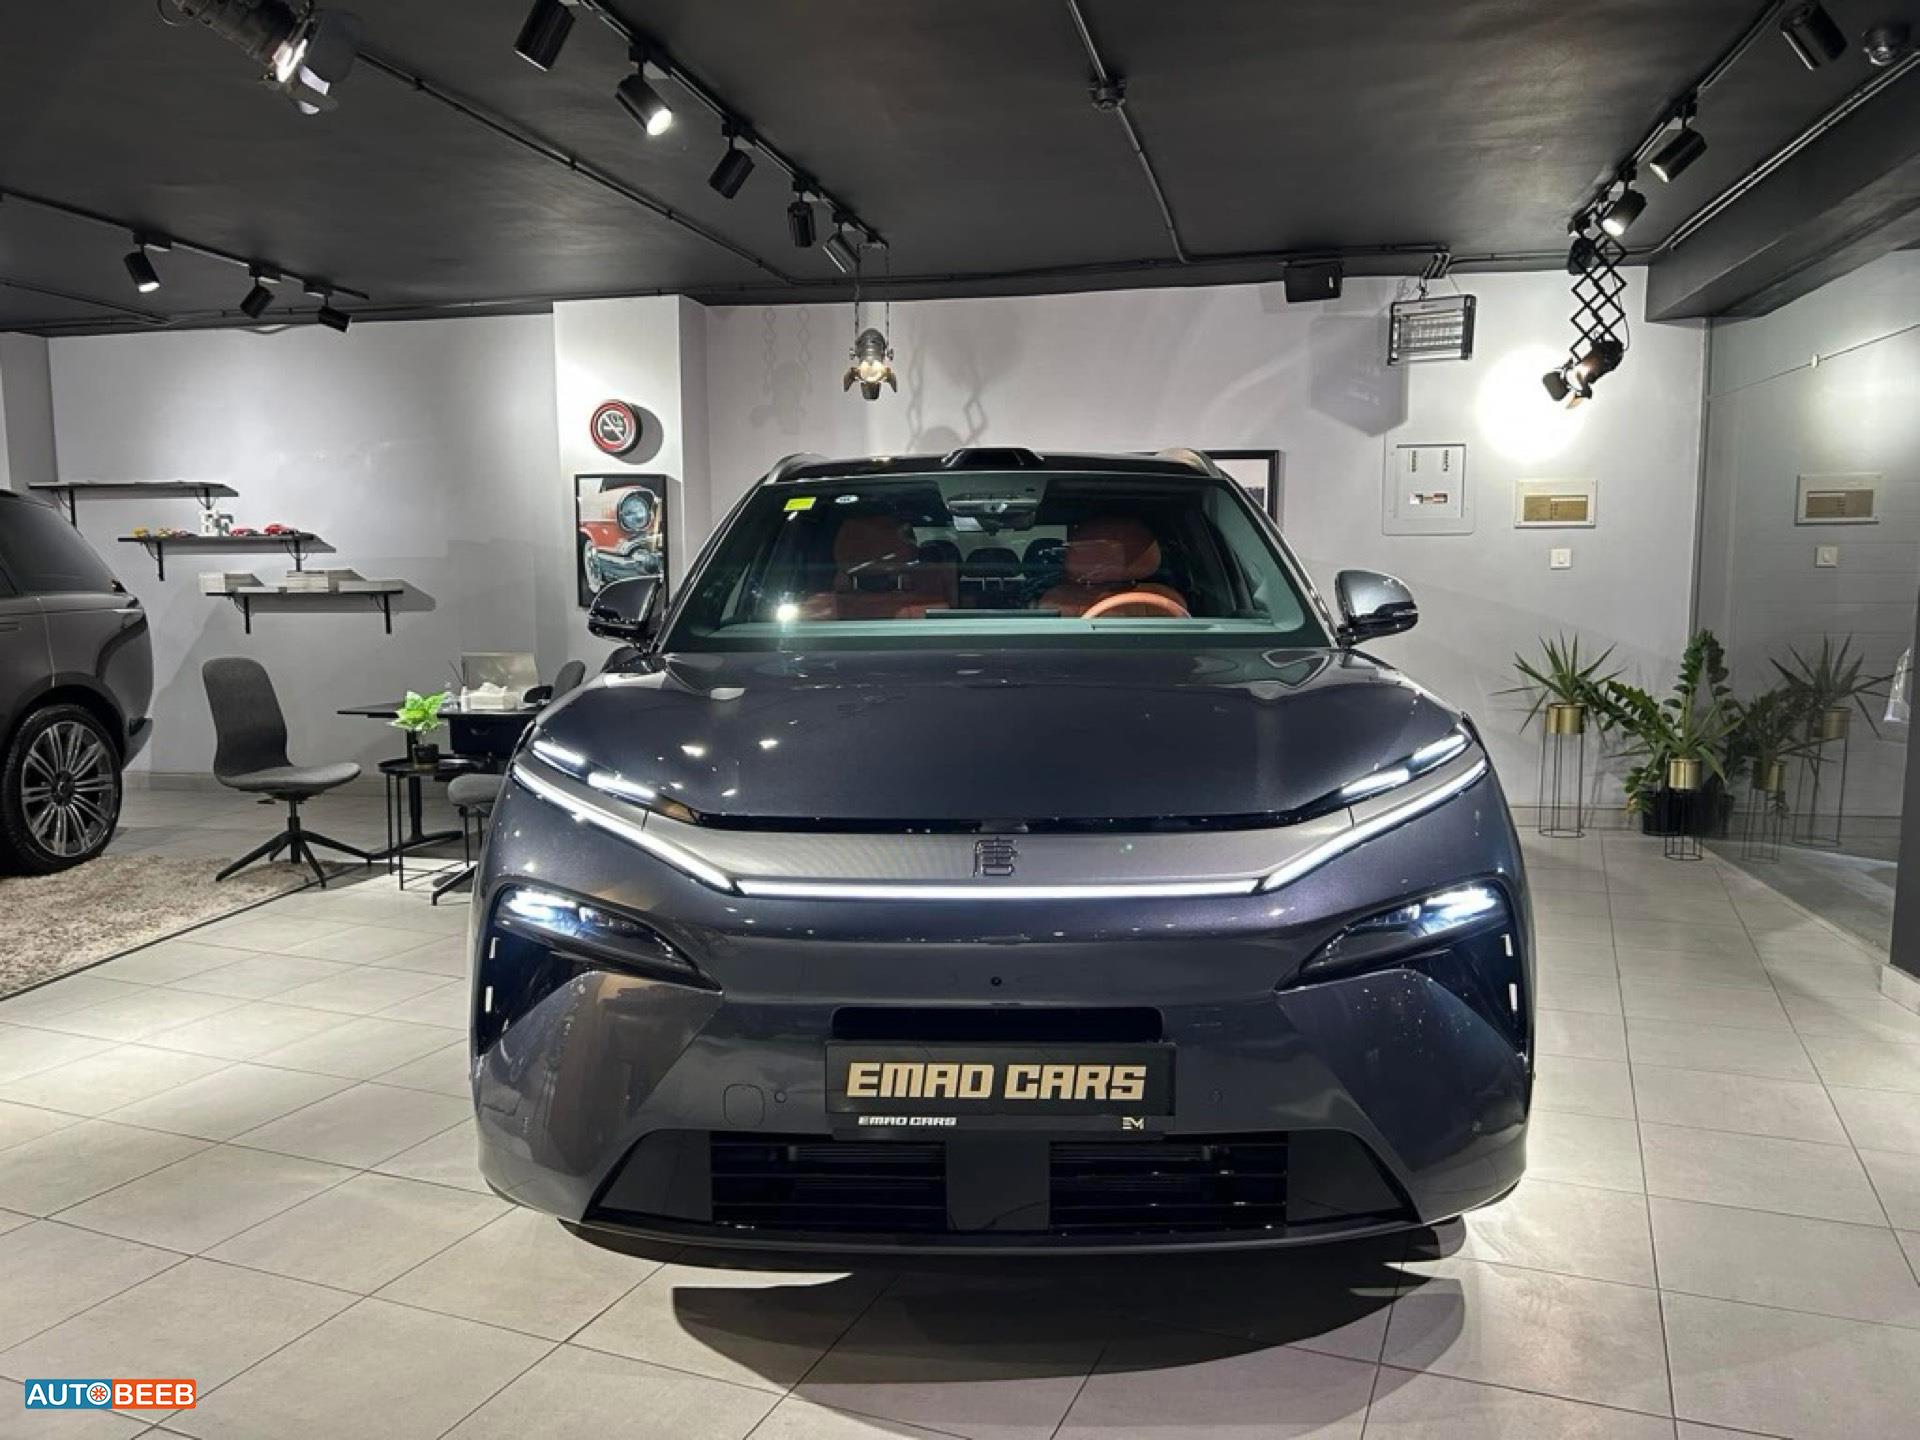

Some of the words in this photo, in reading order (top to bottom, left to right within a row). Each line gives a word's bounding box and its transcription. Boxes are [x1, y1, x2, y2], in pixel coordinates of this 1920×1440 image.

[847, 1062, 994, 1098] EMAD
[1004, 1064, 1147, 1100] CARS
[858, 1115, 908, 1126] EMAD
[909, 1116, 957, 1126] CARS
